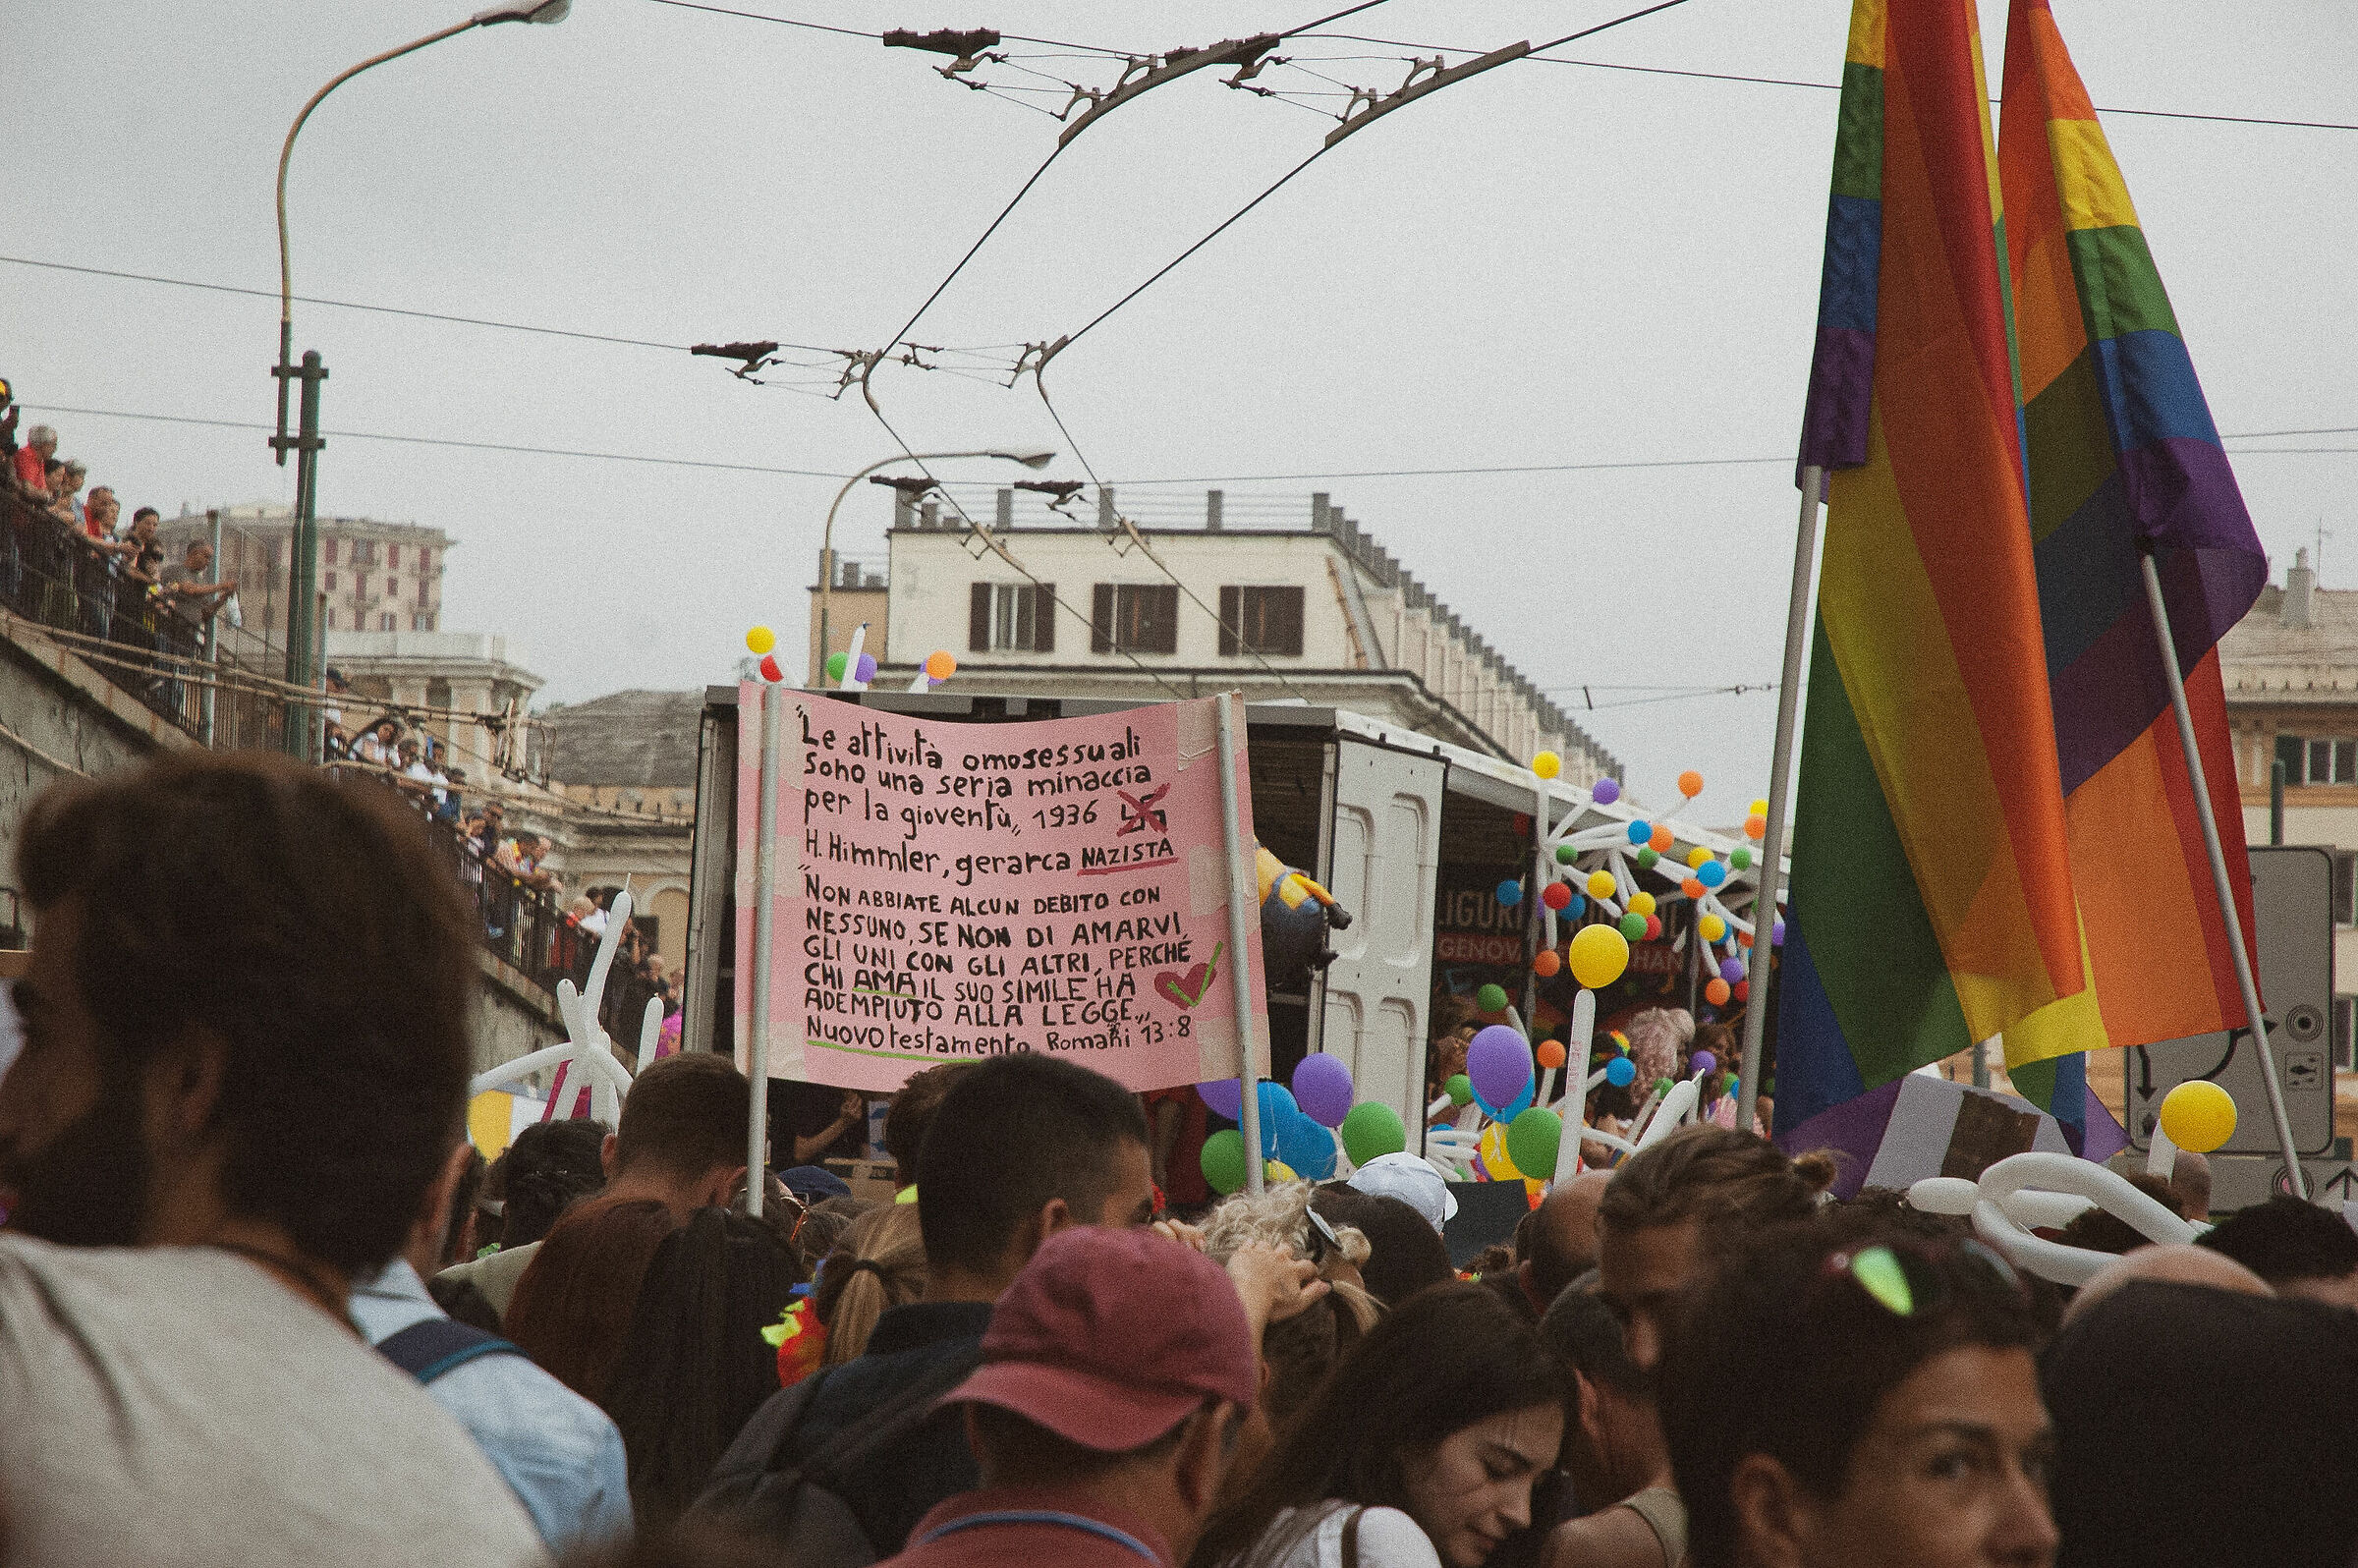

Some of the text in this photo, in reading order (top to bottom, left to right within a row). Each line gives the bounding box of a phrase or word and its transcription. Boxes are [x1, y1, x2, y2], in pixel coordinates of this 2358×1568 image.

[847, 720, 943, 770] attività
[962, 725, 1141, 772] omosessuali
[877, 769, 925, 796] una
[935, 774, 1013, 799] seria
[1028, 764, 1151, 797] minaccia
[804, 788, 853, 826] per
[865, 787, 889, 821] la
[1032, 799, 1099, 830] 1936
[806, 828, 822, 859] H.
[955, 851, 1071, 887] gerarca
[1081, 837, 1174, 869] NAZISTA
[858, 889, 942, 915] ABBIATE
[949, 896, 1020, 918] ALCUN
[1034, 892, 1109, 915] DEBITO
[1119, 886, 1160, 908] CON
[806, 906, 914, 946] NESSUNO,
[918, 921, 949, 948] SE
[957, 923, 1012, 950] NON
[1026, 924, 1054, 948] DI
[804, 934, 842, 962] GLI
[853, 943, 896, 971] UNI
[906, 950, 954, 975] CON
[968, 954, 1005, 979] GLI
[1109, 933, 1193, 971] PERCHÉ
[1437, 936, 1523, 964] GENOV
[804, 962, 1137, 1005] CHI AMA IL SUO SIMILE HA
[804, 987, 943, 1025] ADEMPIUTO
[954, 1004, 1024, 1028] ALLA
[888, 1022, 1031, 1056] testamento
